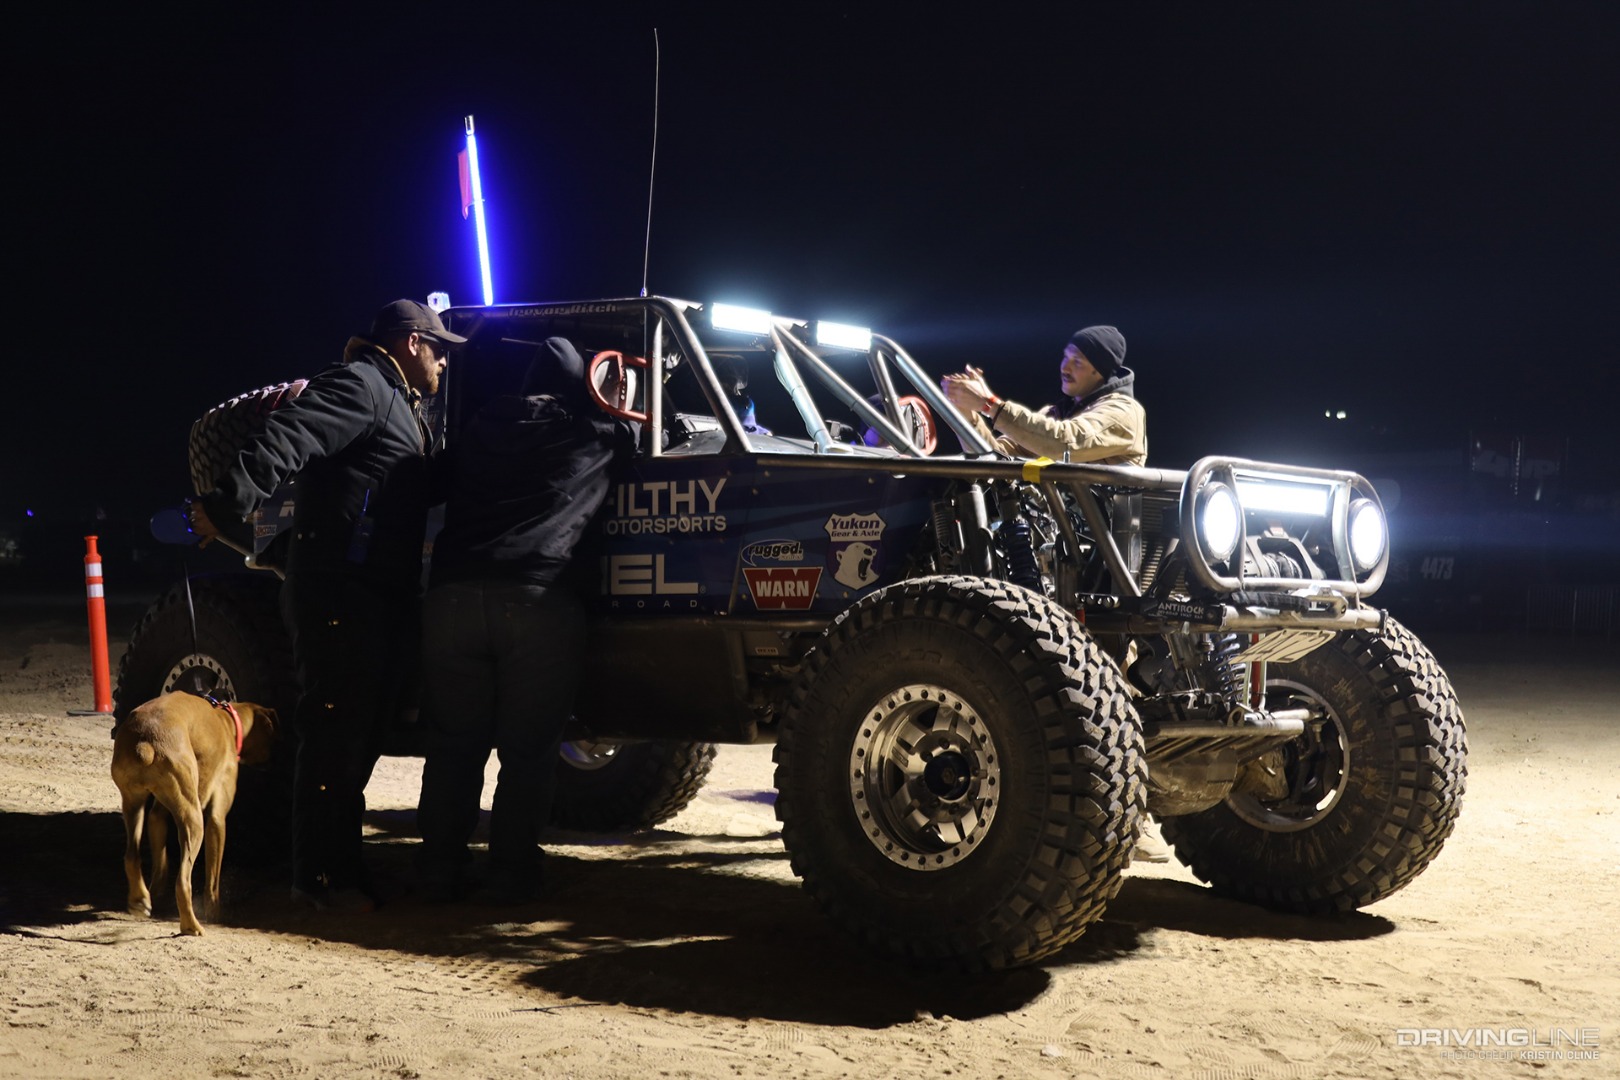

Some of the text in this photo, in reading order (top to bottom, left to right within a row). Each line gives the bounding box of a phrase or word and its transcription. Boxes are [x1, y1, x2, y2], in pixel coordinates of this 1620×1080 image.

[606, 478, 728, 518] ILTHY
[604, 515, 728, 536] OTORSPORTS
[830, 518, 880, 530] Yukon
[831, 530, 850, 538] Gear
[755, 580, 809, 597] WARN
[1158, 602, 1205, 615] ANTIROCK
